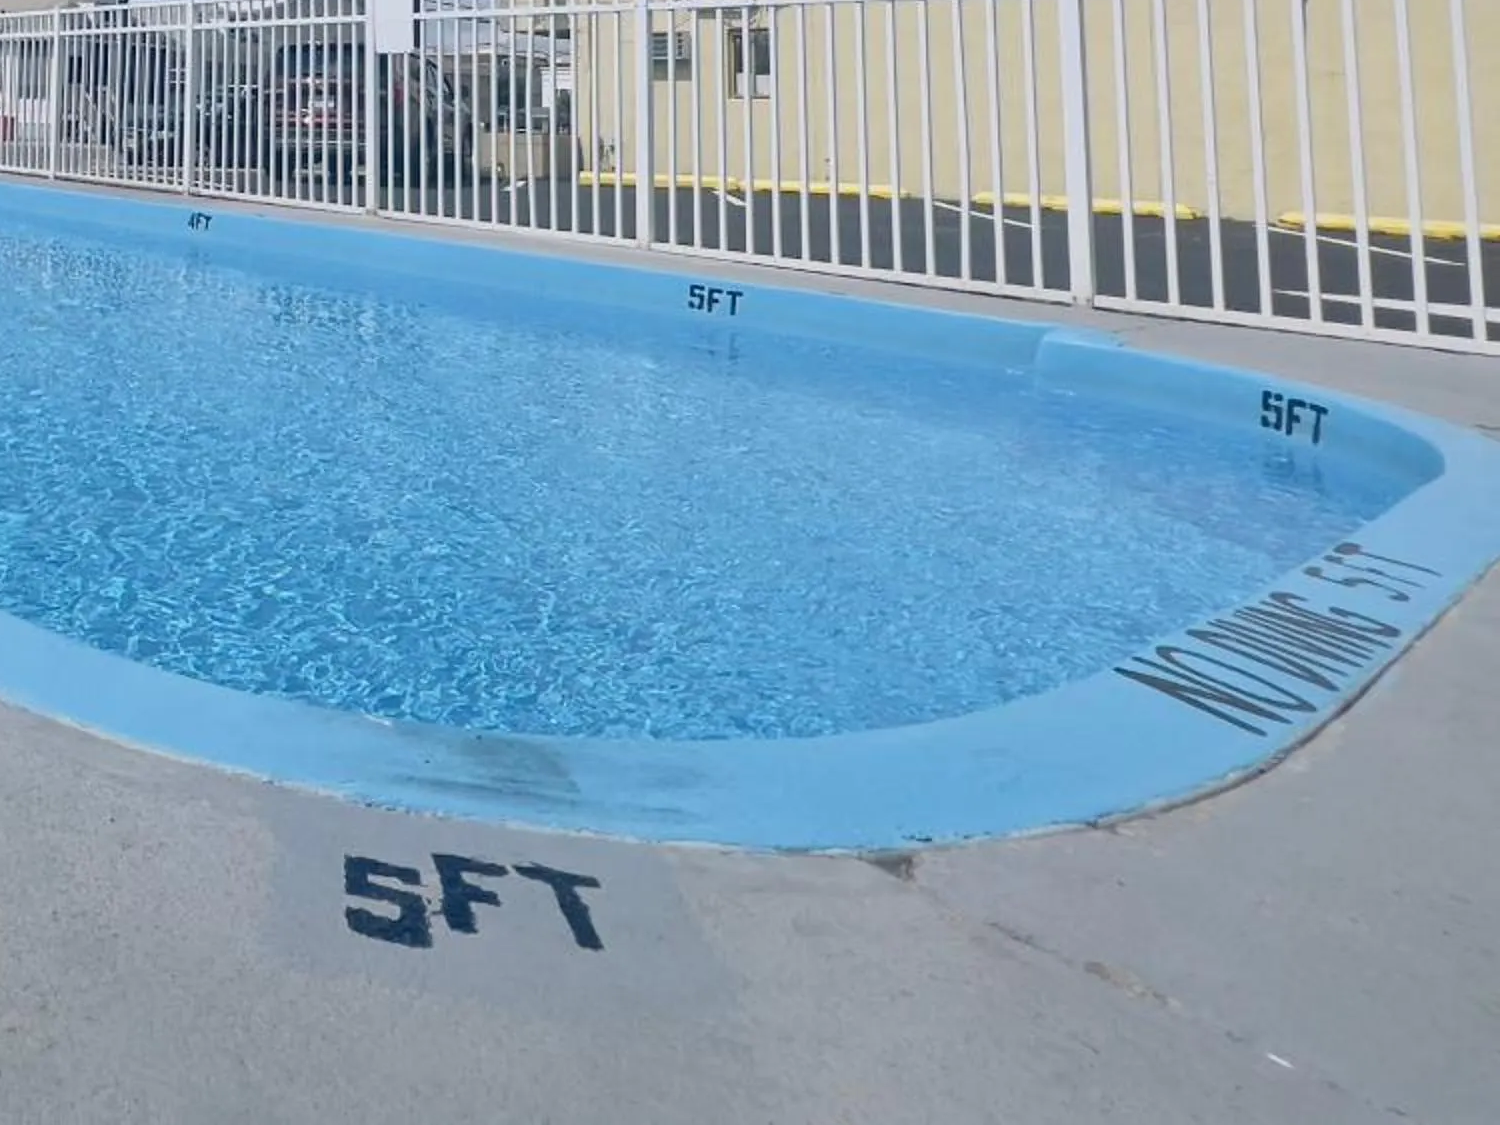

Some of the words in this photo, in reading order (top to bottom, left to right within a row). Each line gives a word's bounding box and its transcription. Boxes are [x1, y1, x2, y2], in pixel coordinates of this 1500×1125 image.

[187, 212, 212, 231] 4FT
[688, 284, 744, 316] 5FT
[1261, 390, 1328, 444] 5FT
[1185, 591, 1402, 693] DIVING
[1113, 645, 1318, 737] NO
[344, 853, 604, 951] 5FT
